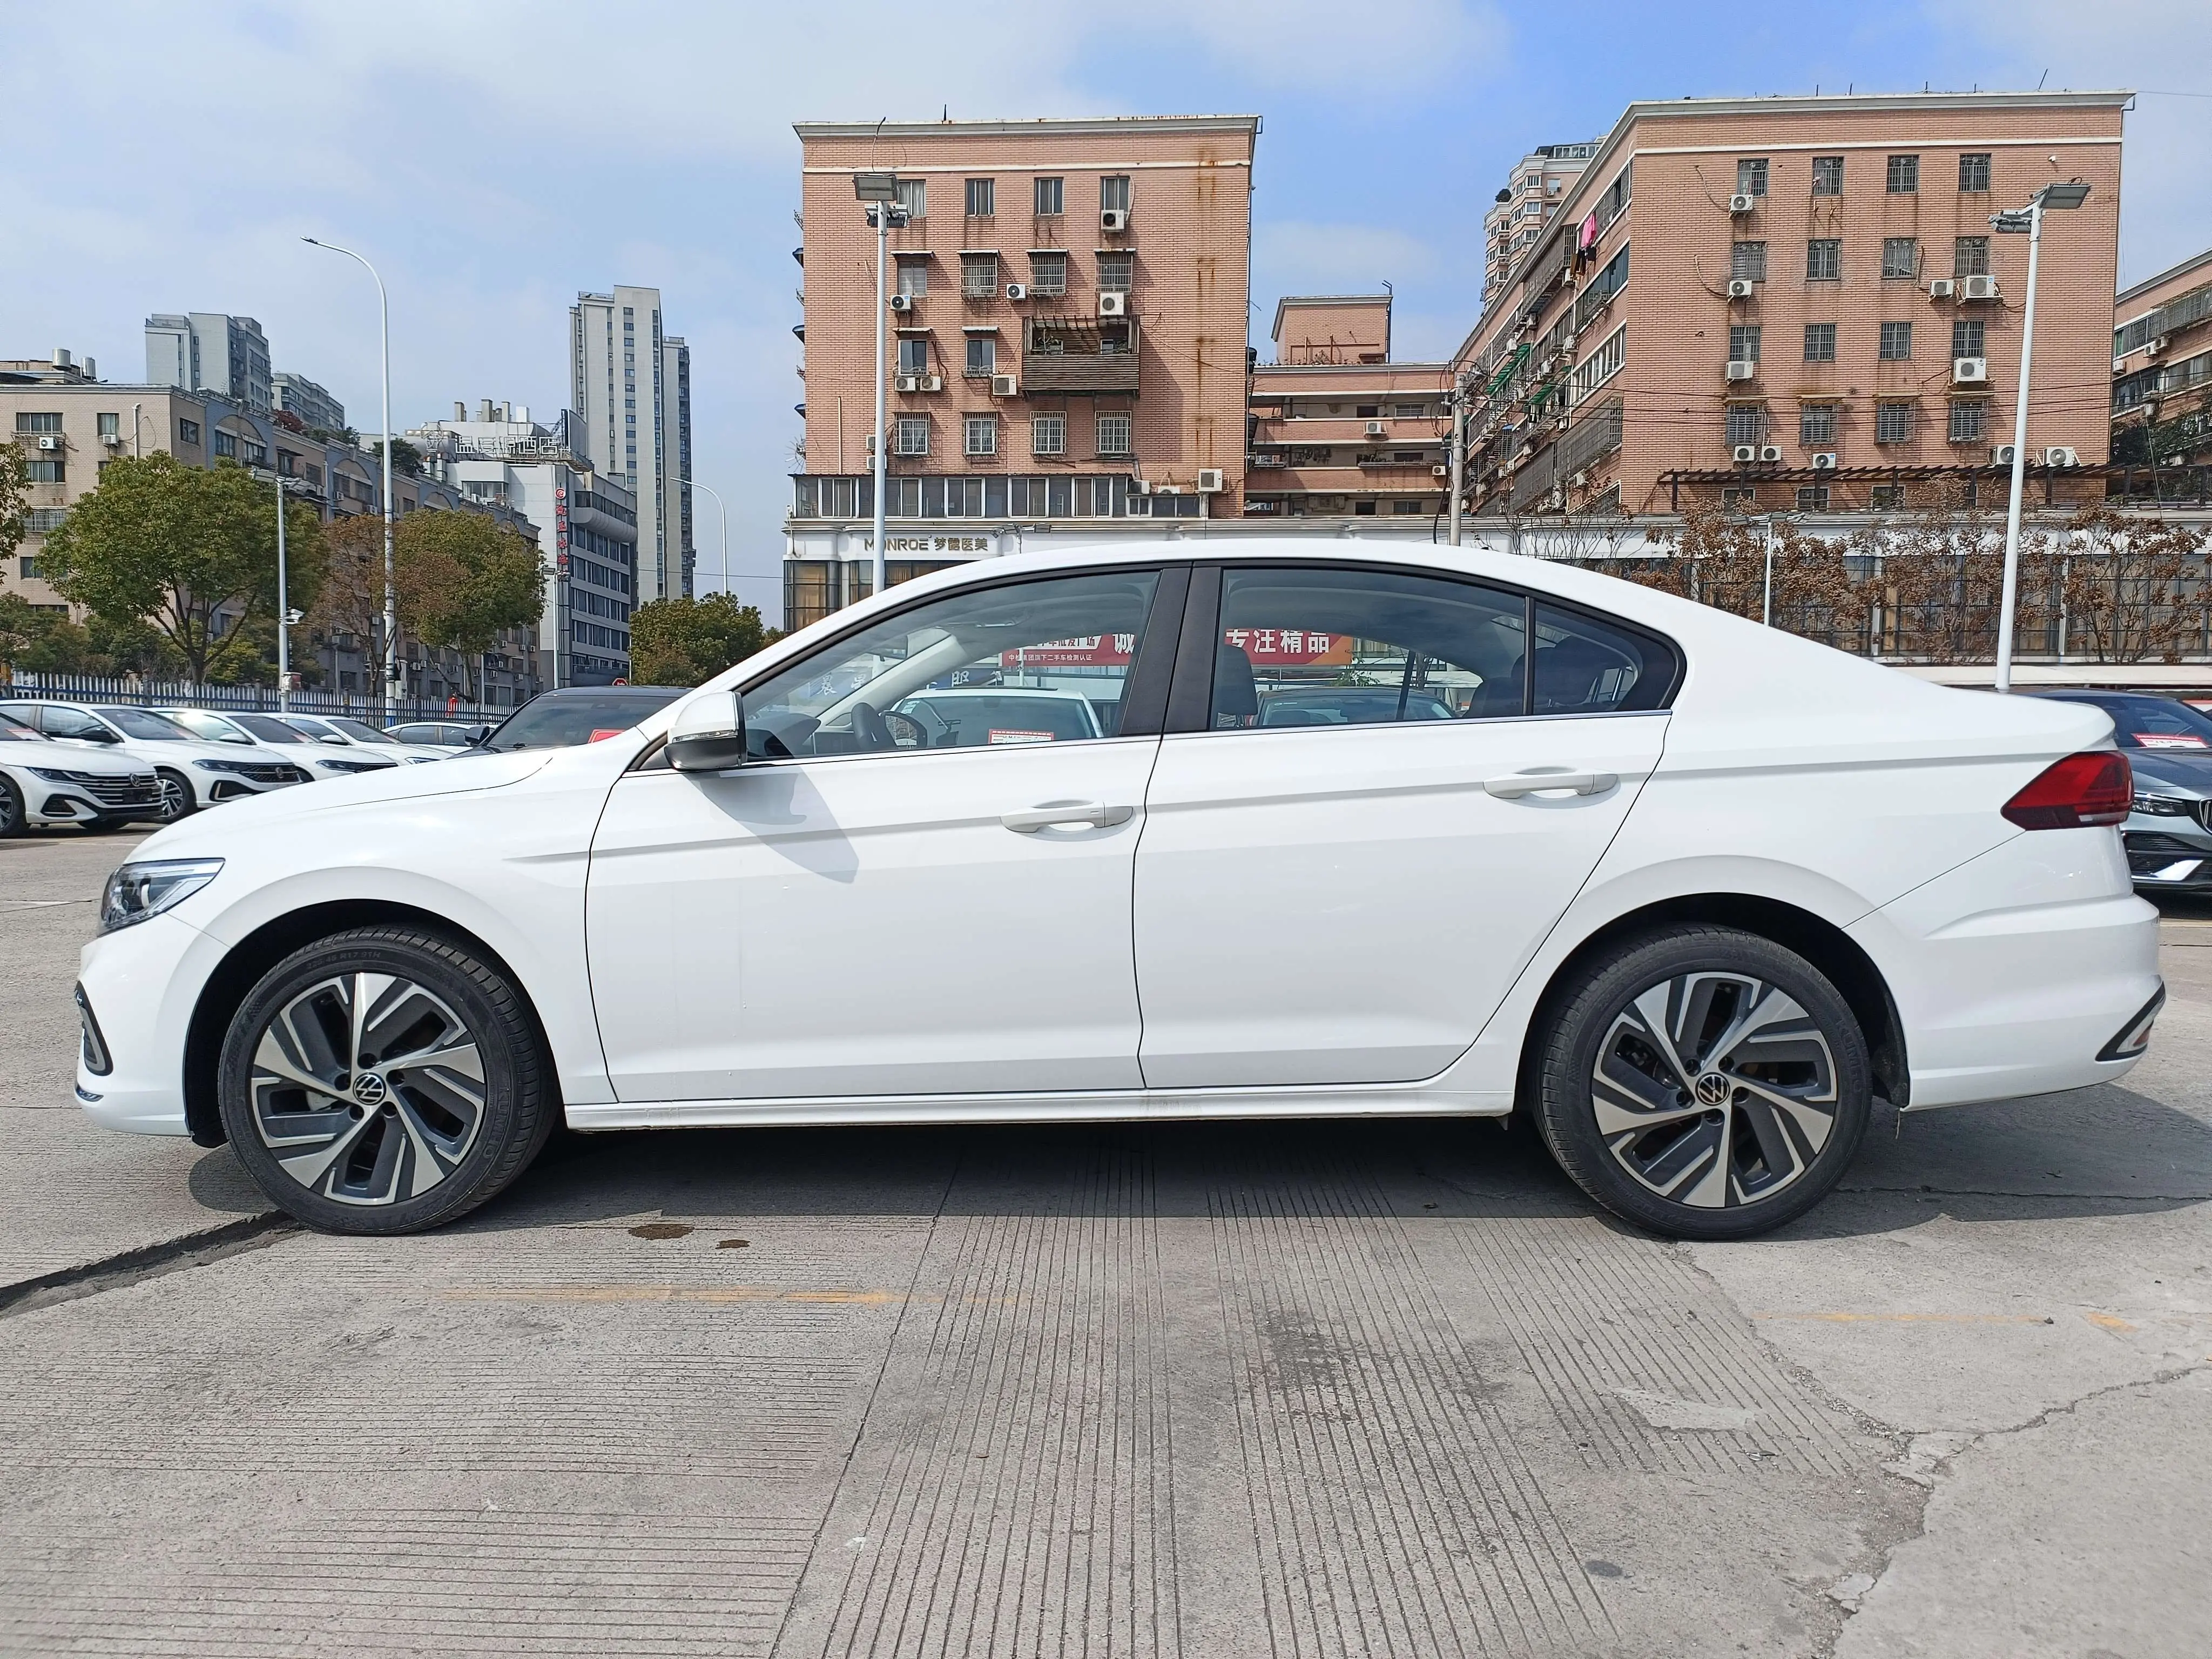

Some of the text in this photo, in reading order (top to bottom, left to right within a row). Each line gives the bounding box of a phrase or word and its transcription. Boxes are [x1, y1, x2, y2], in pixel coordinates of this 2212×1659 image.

[864, 537, 988, 551] MNROE 梦露医美
